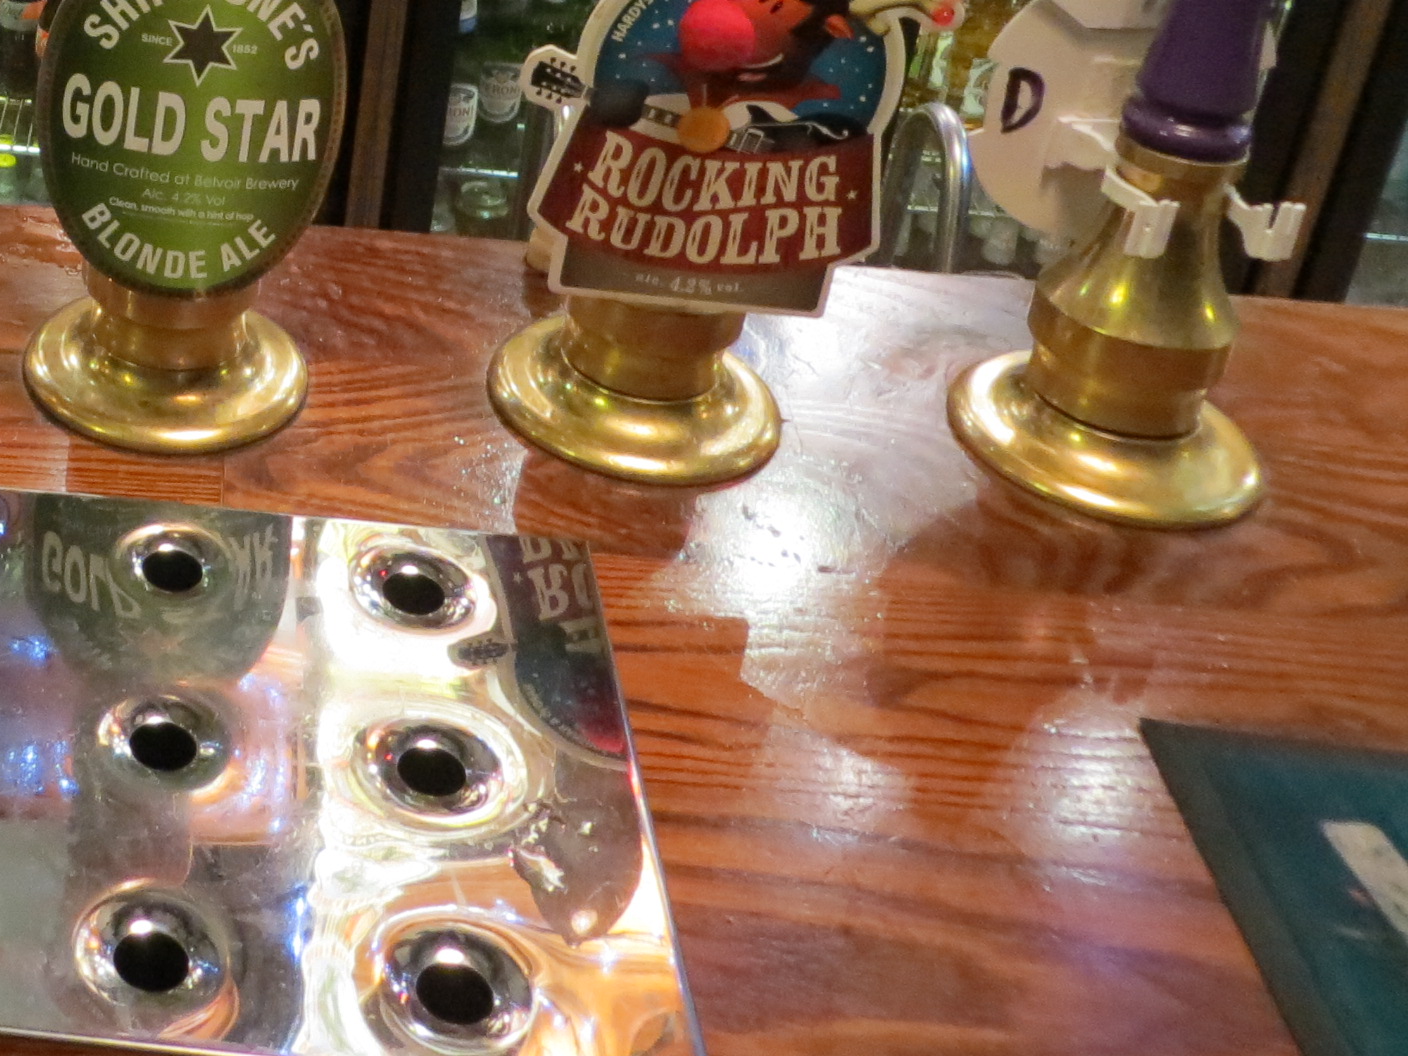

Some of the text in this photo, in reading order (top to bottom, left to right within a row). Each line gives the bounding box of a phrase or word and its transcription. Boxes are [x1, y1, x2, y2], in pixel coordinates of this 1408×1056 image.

[141, 31, 259, 56] SINCE 1852
[61, 72, 322, 164] GOLD STAR
[70, 151, 300, 192] Hand Crafted at Belvoir Brewery
[205, 194, 226, 206] Vol
[588, 130, 841, 213] ROCKING
[80, 200, 277, 280] BLONDE ALE
[140, 202, 177, 217] smooth
[177, 206, 197, 219] with
[206, 209, 225, 221] hint
[564, 185, 843, 266] RUDOLPH
